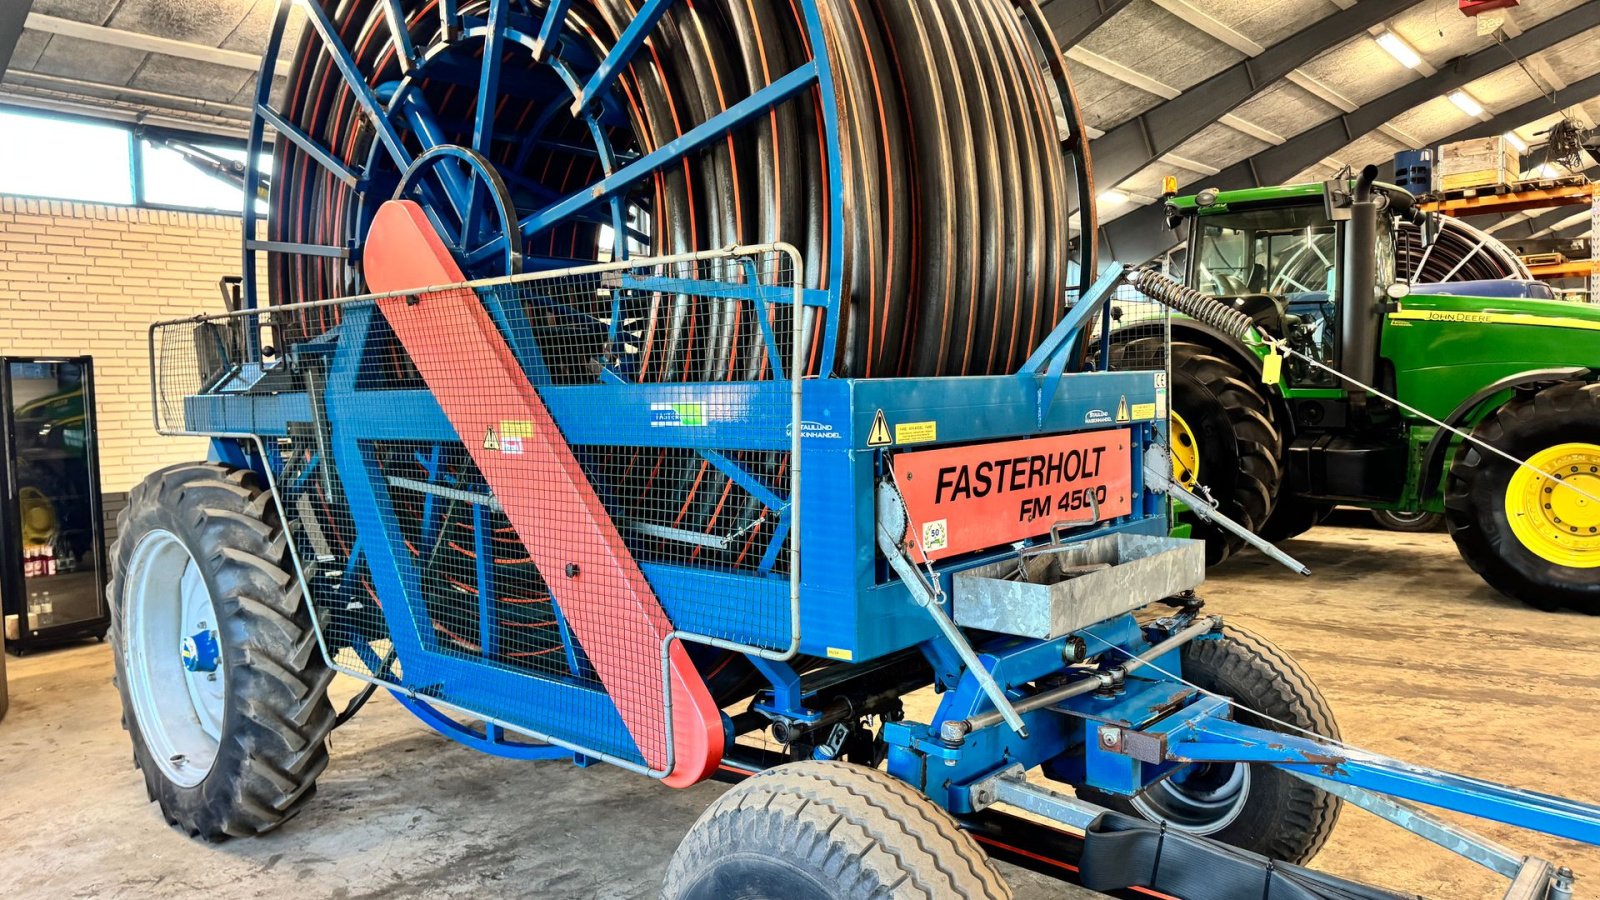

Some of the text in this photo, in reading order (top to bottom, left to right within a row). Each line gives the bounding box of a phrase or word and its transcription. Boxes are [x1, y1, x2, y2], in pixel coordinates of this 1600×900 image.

[1428, 312, 1492, 323] JOHN DEERE
[786, 430, 842, 439] MKINHANDEL
[935, 446, 1106, 504] FASTERHOLT
[1019, 495, 1052, 522] FM
